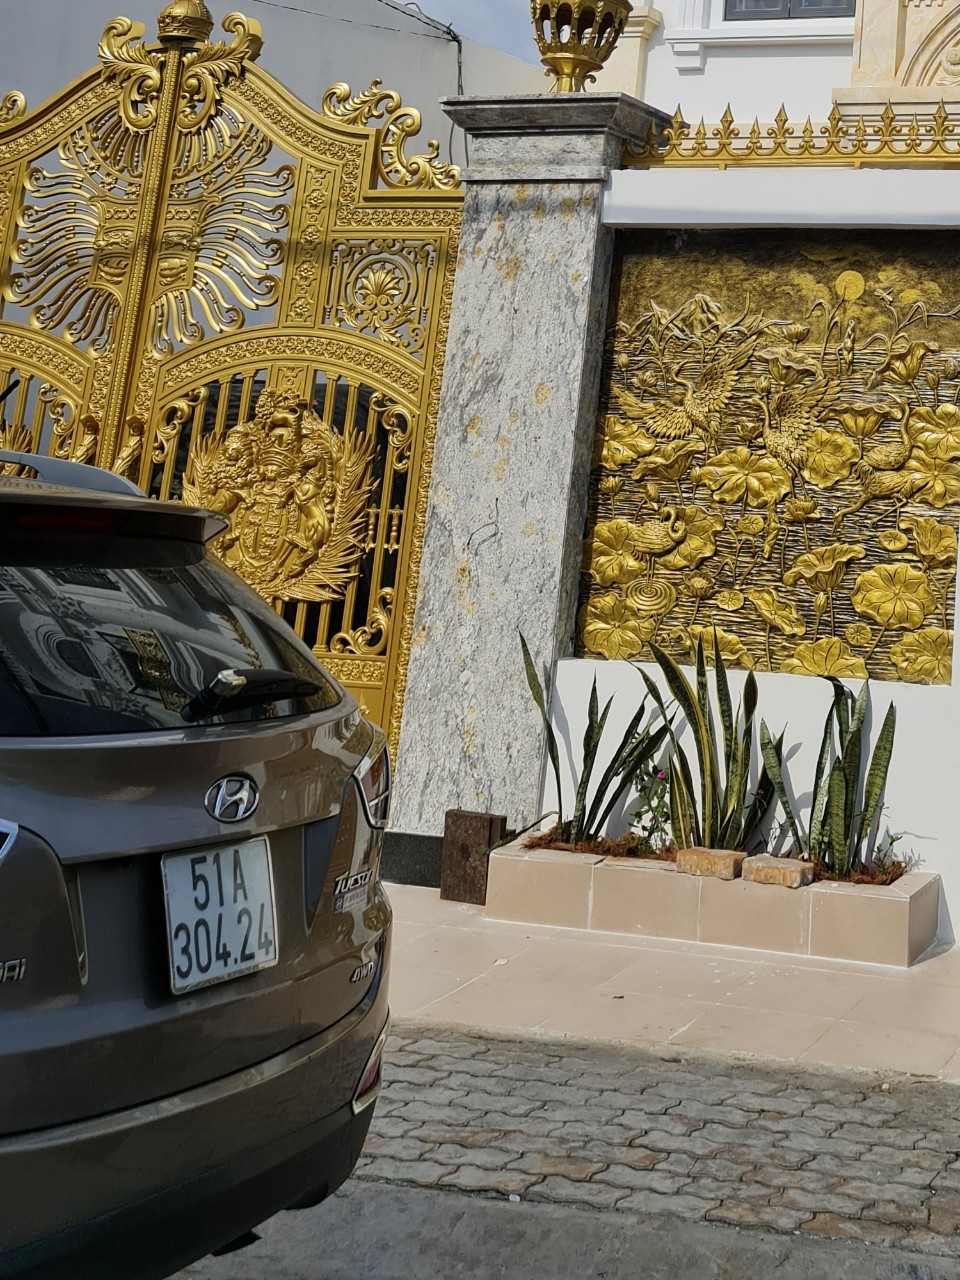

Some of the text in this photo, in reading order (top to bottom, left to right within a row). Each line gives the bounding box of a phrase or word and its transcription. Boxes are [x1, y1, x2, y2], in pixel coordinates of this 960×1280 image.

[190, 849, 248, 911] 51A
[174, 903, 273, 979] 304.24
[351, 961, 374, 982] 4WD
